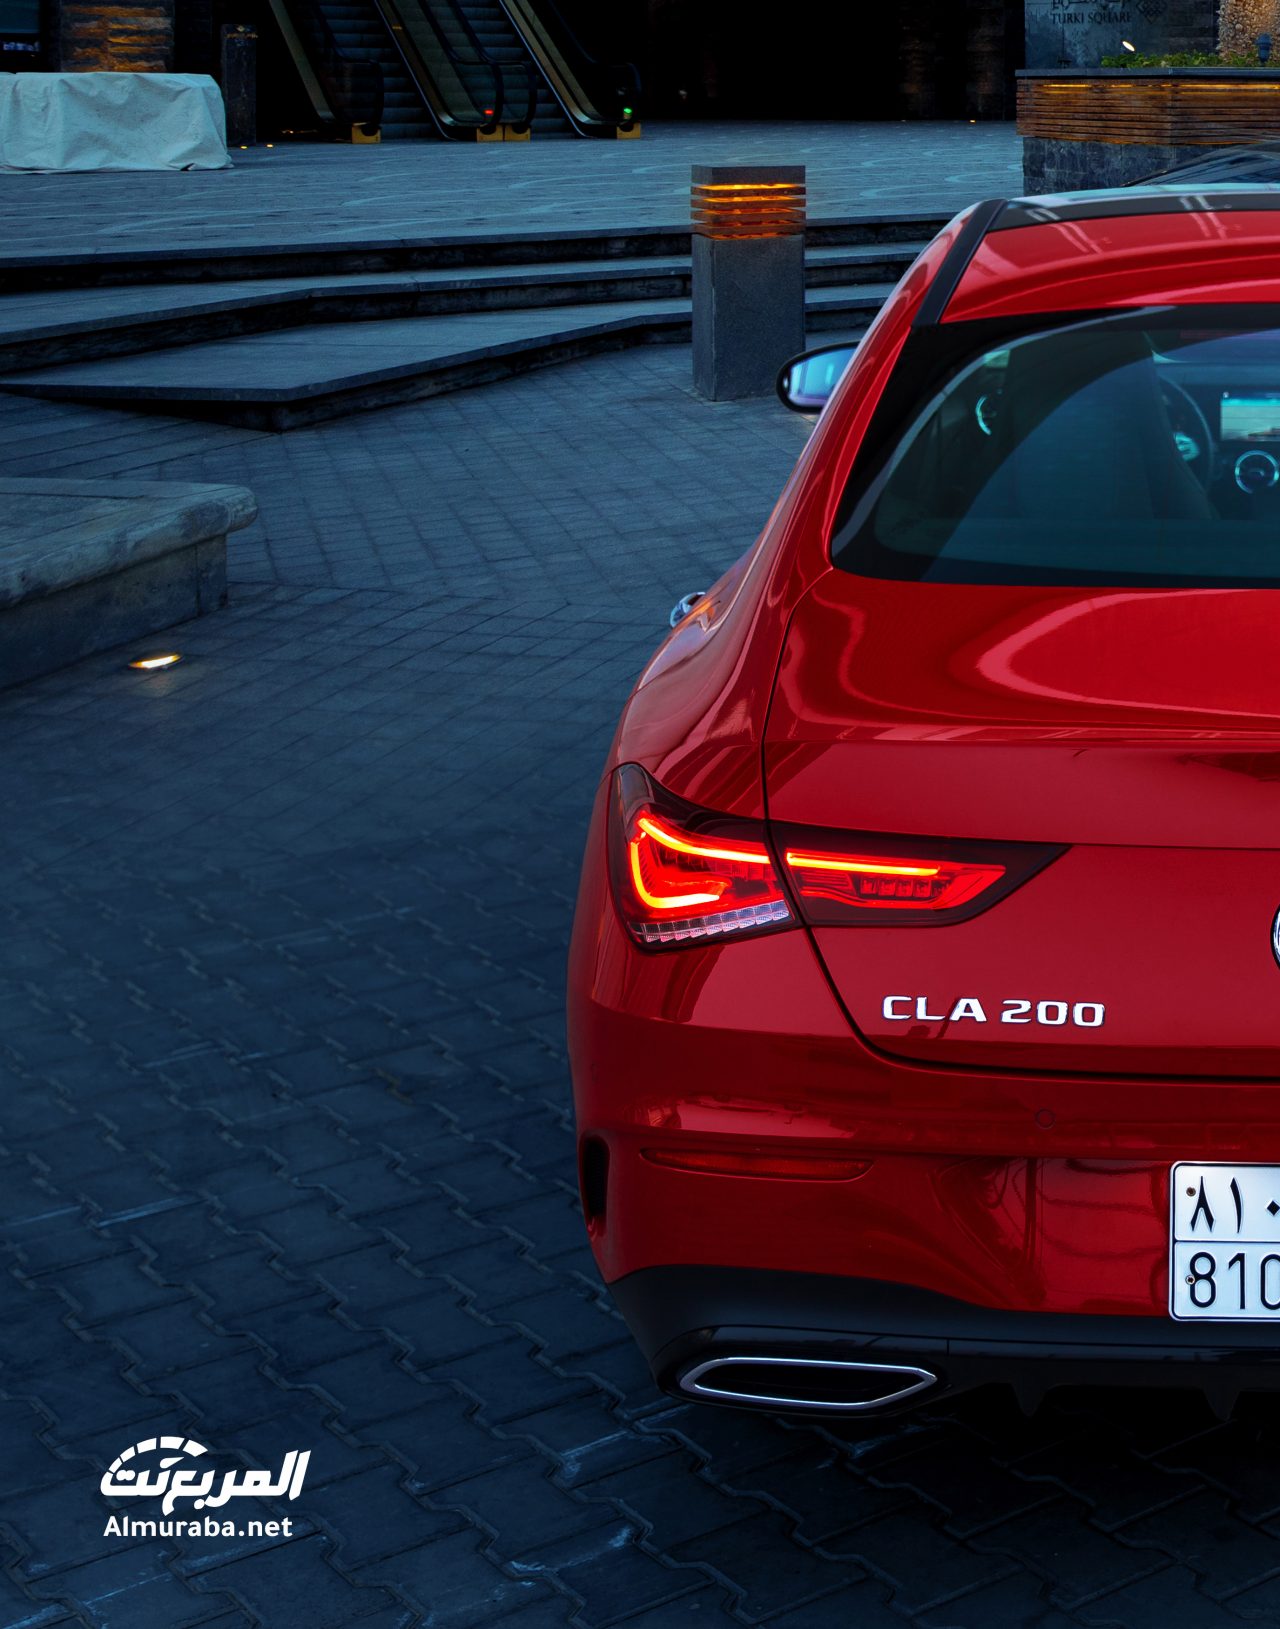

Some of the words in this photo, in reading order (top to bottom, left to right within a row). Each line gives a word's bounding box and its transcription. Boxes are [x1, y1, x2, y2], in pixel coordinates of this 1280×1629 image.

[1050, 12, 1084, 24] TURKI
[882, 995, 988, 1022] CLA
[1000, 999, 1106, 1027] 200
